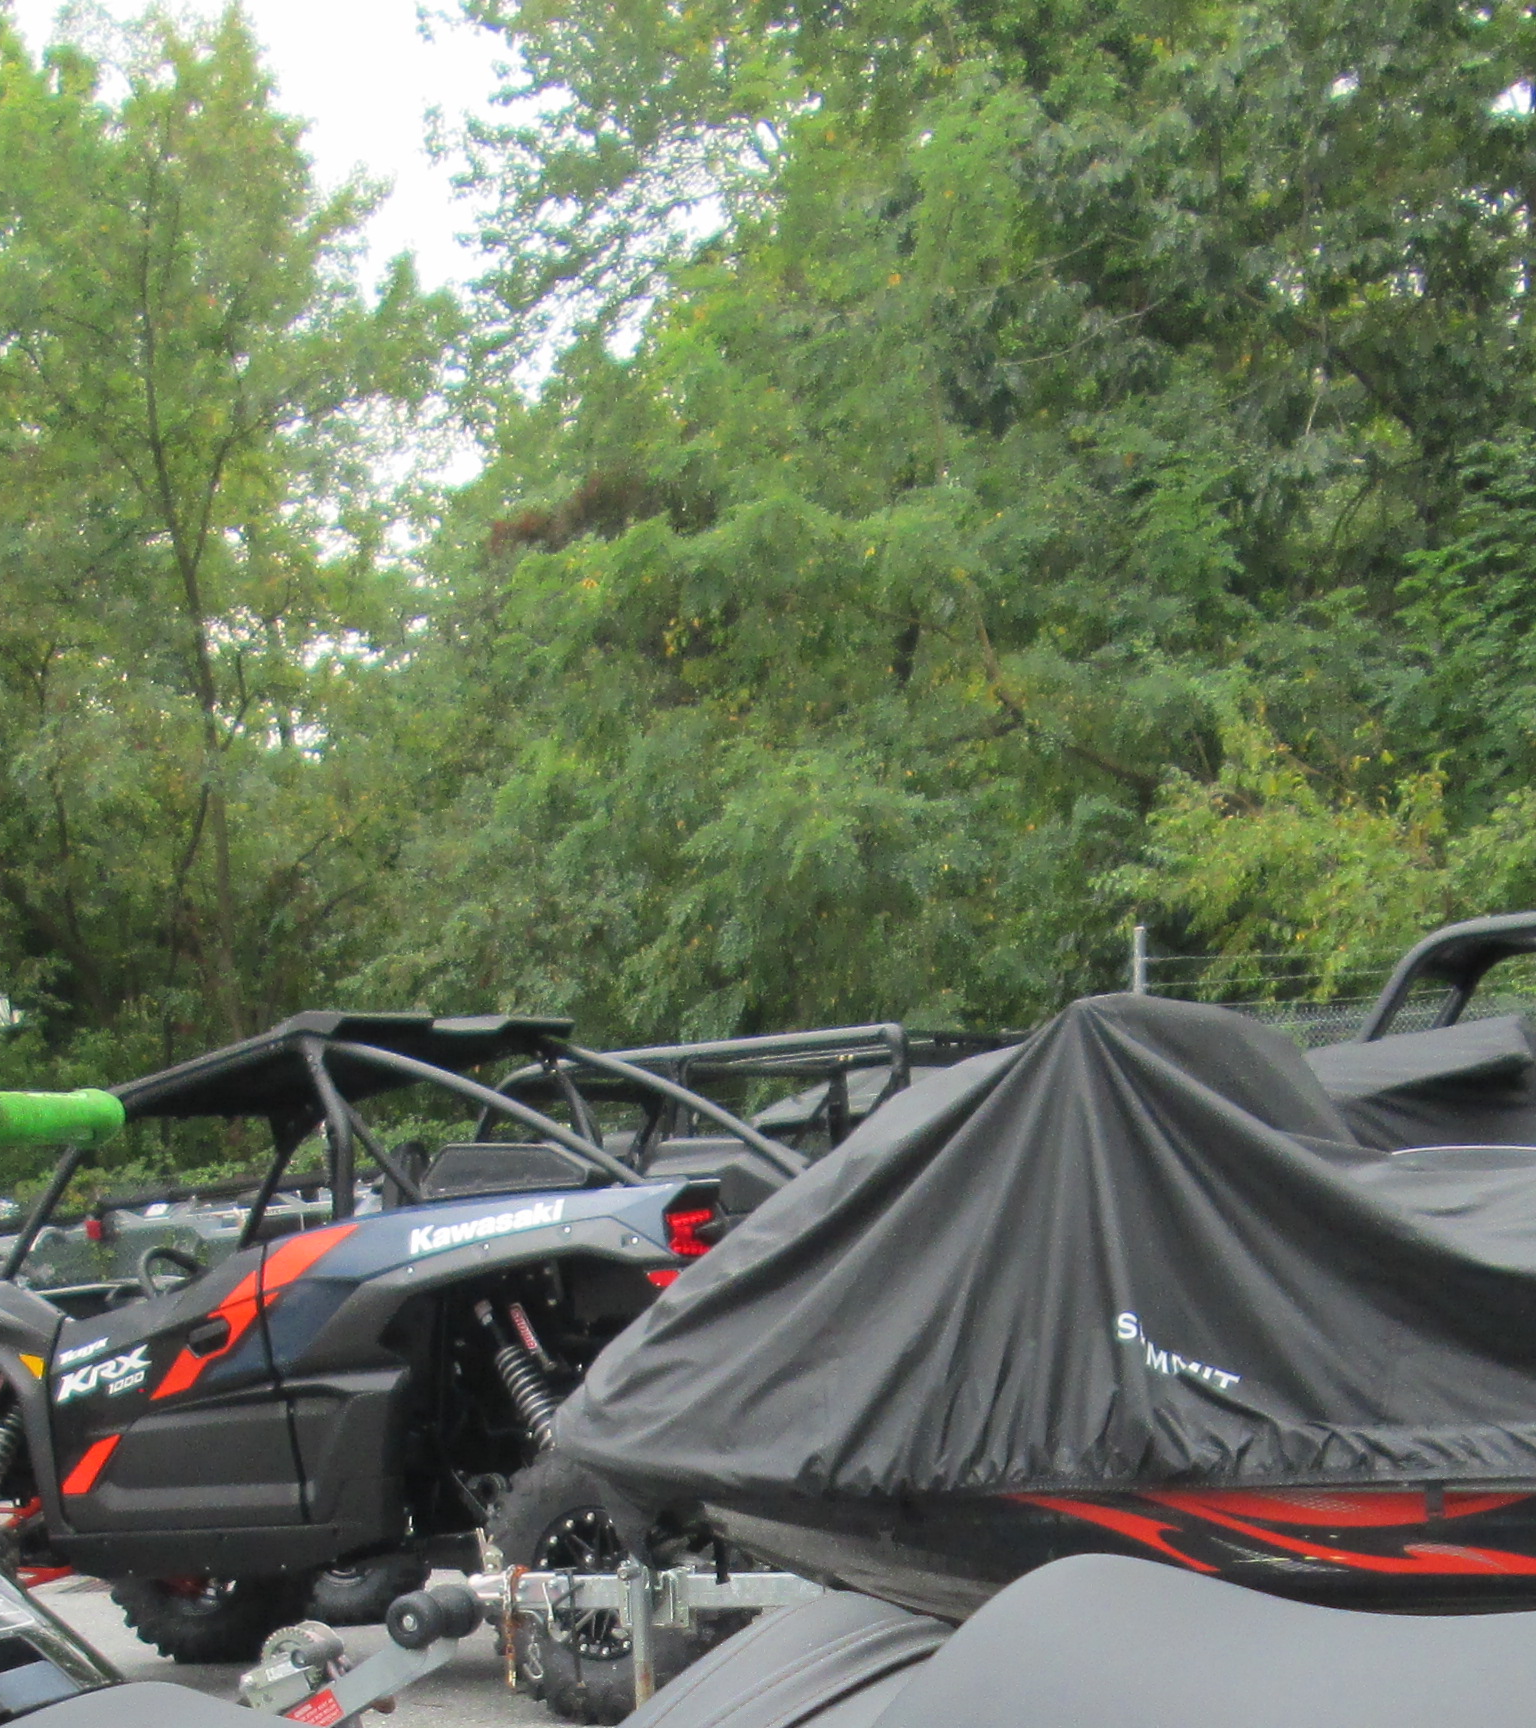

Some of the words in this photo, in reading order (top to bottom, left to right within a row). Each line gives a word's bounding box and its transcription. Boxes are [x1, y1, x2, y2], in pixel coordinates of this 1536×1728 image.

[409, 1199, 563, 1256] Kawasaki
[57, 1344, 152, 1402] KRX
[1117, 1312, 1241, 1389] SMMIT
[108, 1370, 145, 1395] 1000
